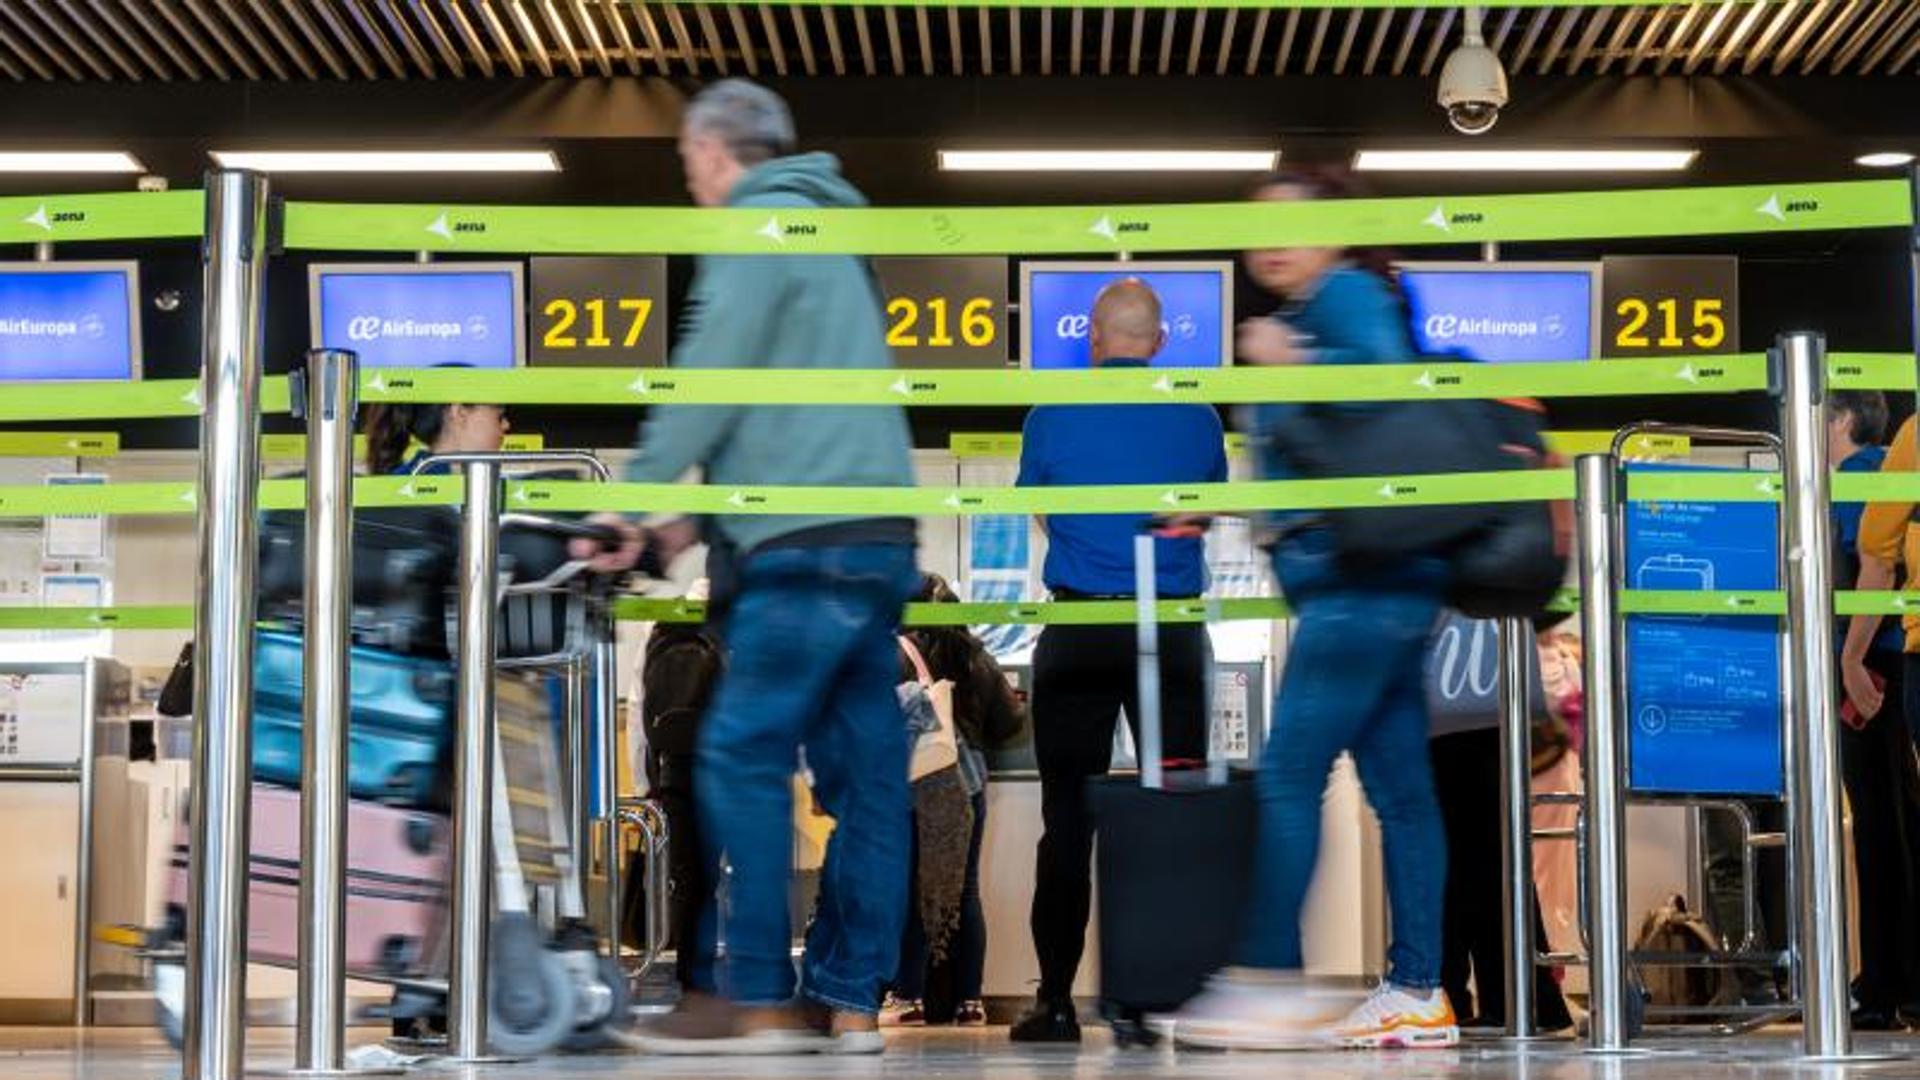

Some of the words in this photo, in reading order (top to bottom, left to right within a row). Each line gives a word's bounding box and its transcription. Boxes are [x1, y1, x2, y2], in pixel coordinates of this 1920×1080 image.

[1785, 201, 1818, 212] aena
[52, 211, 85, 222] aena
[1450, 213, 1484, 224] aena
[454, 222, 486, 233] aena
[784, 225, 817, 235] aena
[1117, 222, 1150, 233] aena
[543, 299, 653, 348] 217
[886, 297, 995, 347] 216
[1615, 298, 1724, 348] 215
[382, 320, 461, 338] AirEuropa
[1458, 319, 1537, 337] AirEuropa
